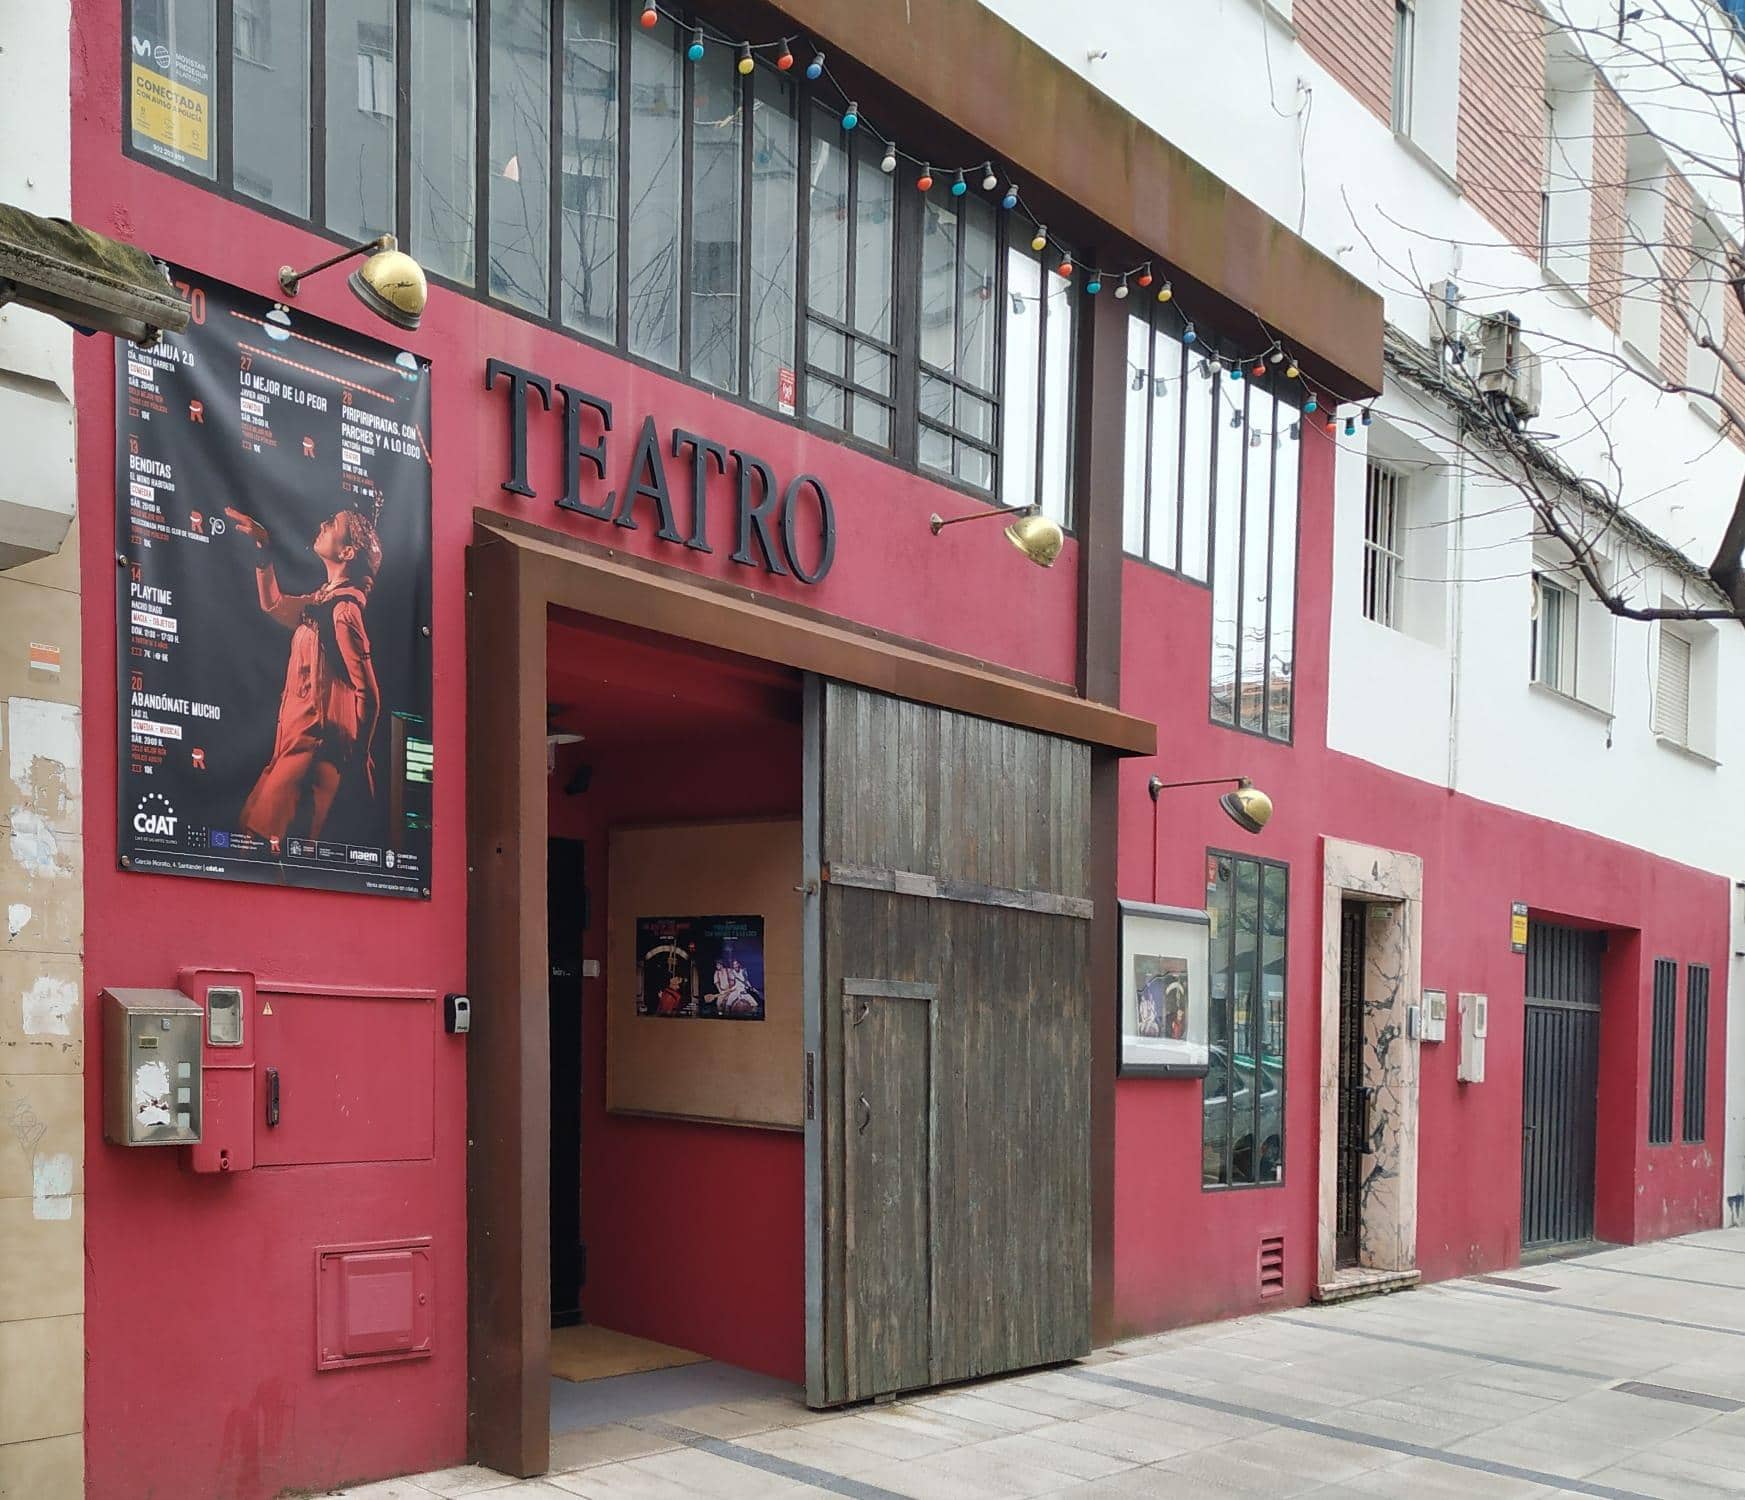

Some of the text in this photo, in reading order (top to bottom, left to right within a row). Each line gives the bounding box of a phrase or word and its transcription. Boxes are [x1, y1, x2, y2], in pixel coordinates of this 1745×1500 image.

[175, 54, 206, 72] MOVISTAR
[175, 61, 208, 81] PROSEGUR
[136, 77, 203, 114] CONECTADA
[136, 89, 150, 100] CON
[152, 96, 172, 110] AVISO
[130, 363, 151, 377] COMEDIA
[240, 356, 252, 371] 27
[240, 371, 327, 412] LO MEJOR DE LO PEOR
[342, 390, 352, 406] 28
[402, 424, 417, 440] CON
[341, 422, 421, 460] PARCHES Y A LO LOCO
[130, 454, 172, 479] BENDITAS
[485, 357, 836, 585] TEATRO
[130, 471, 135, 481] EL
[131, 484, 152, 497] COMEDIA
[131, 567, 141, 582] 14
[131, 582, 173, 605] PLAYTIME
[131, 600, 148, 611] NACHO
[133, 612, 175, 629] MAGIA OBJETOS
[131, 626, 143, 636] DOM.
[131, 676, 142, 691] 20
[131, 691, 221, 720] ABANDÓNATE MUCHO
[133, 721, 180, 737] COMEDIA MUSICAL
[133, 813, 178, 836] CdAT
[349, 849, 378, 862] inaem
[177, 861, 202, 871] Santander
[1371, 860, 1378, 881] 4
